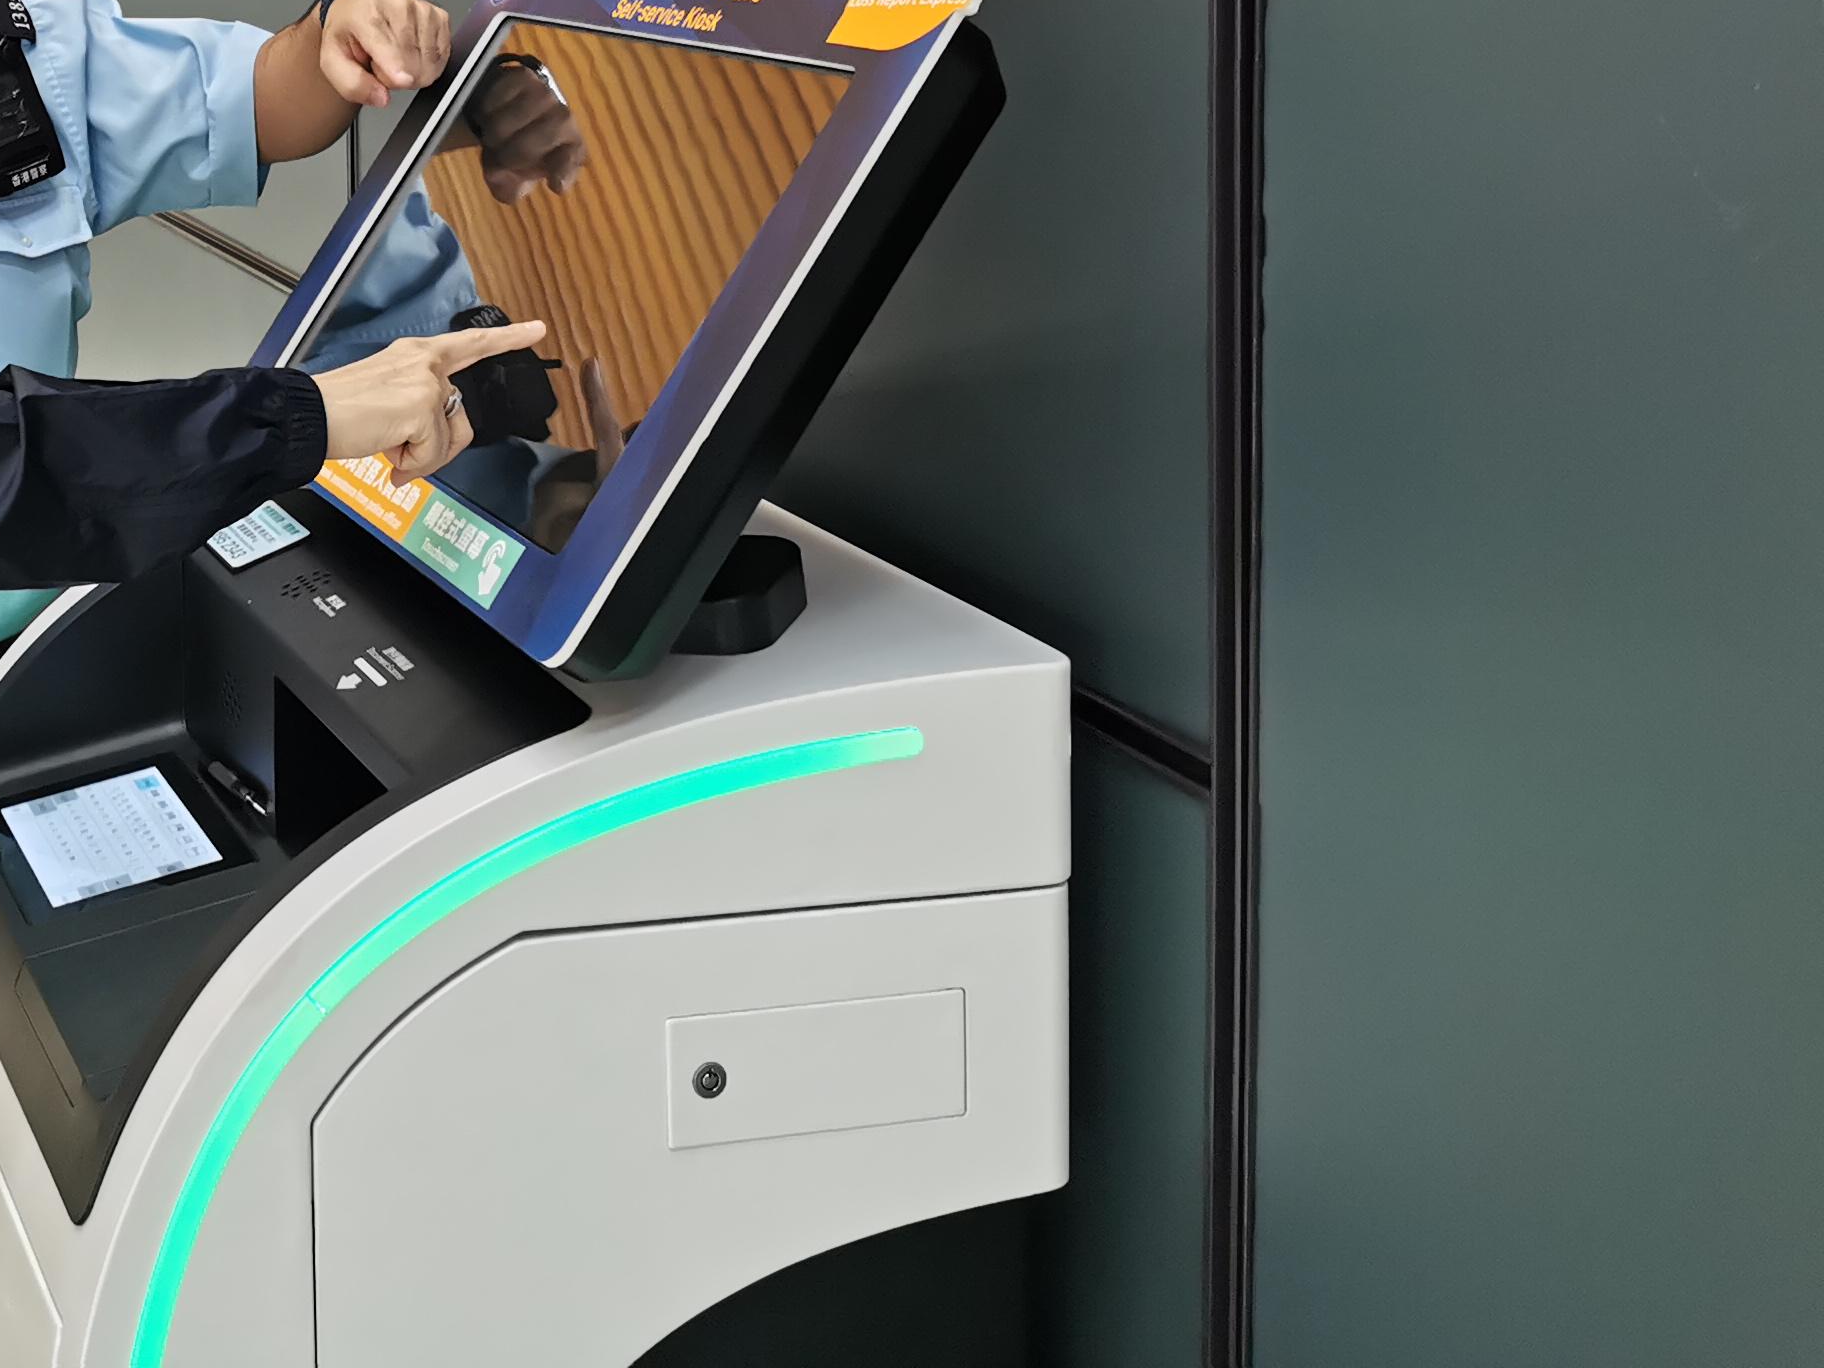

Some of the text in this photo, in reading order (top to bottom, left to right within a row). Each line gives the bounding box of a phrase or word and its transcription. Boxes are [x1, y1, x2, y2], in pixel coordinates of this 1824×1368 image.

[682, 5, 723, 32] Kiosk
[11, 163, 47, 187] 香港警察
